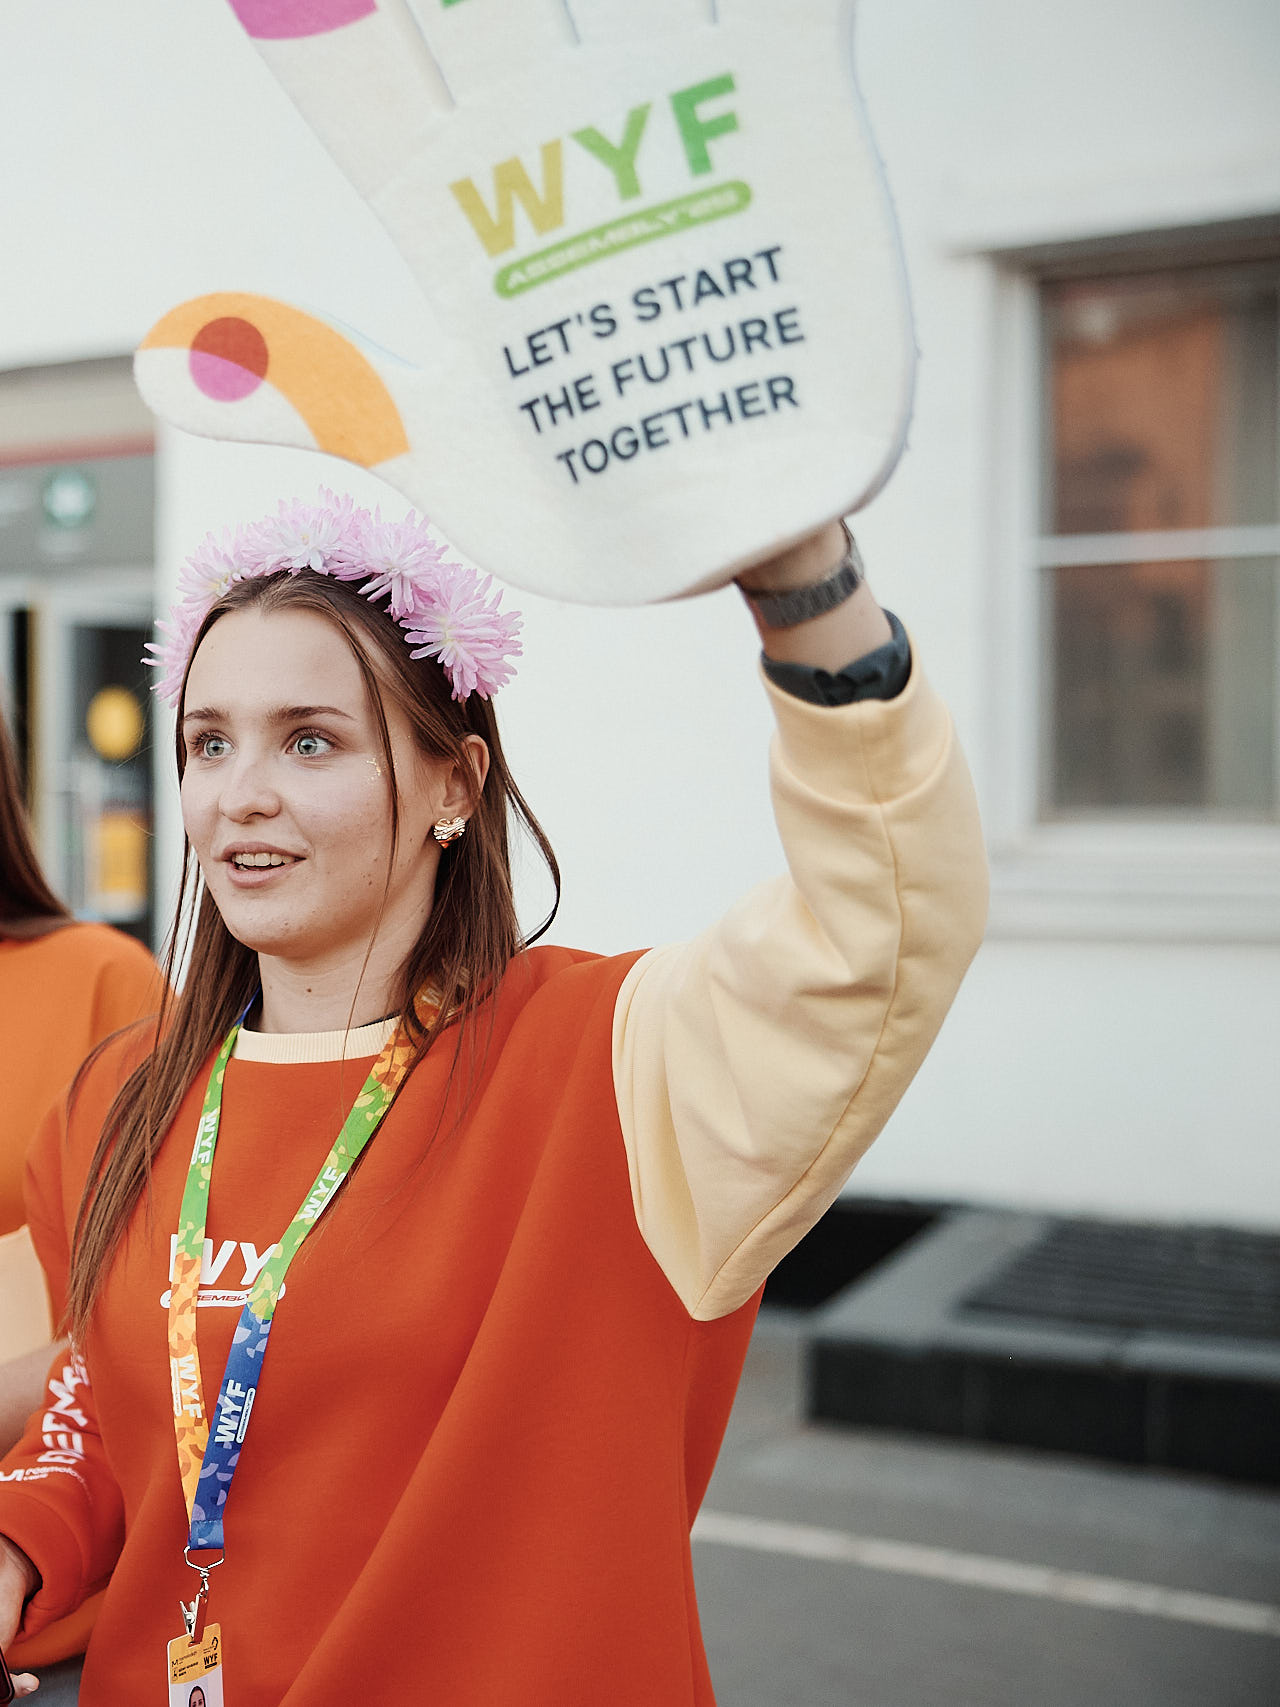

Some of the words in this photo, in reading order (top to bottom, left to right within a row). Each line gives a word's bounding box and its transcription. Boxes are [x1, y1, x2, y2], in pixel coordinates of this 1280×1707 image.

[449, 72, 739, 258] WYF
[503, 305, 617, 378] LET'S
[632, 247, 782, 323] START
[520, 376, 600, 433] THE
[611, 307, 805, 397] FUTURE
[556, 376, 800, 484] TOGETHER
[198, 1107, 219, 1165] WYF
[300, 1166, 340, 1220] WYF
[169, 1234, 282, 1286] WY
[178, 1354, 203, 1418] WYF
[215, 1380, 246, 1442] WYF
